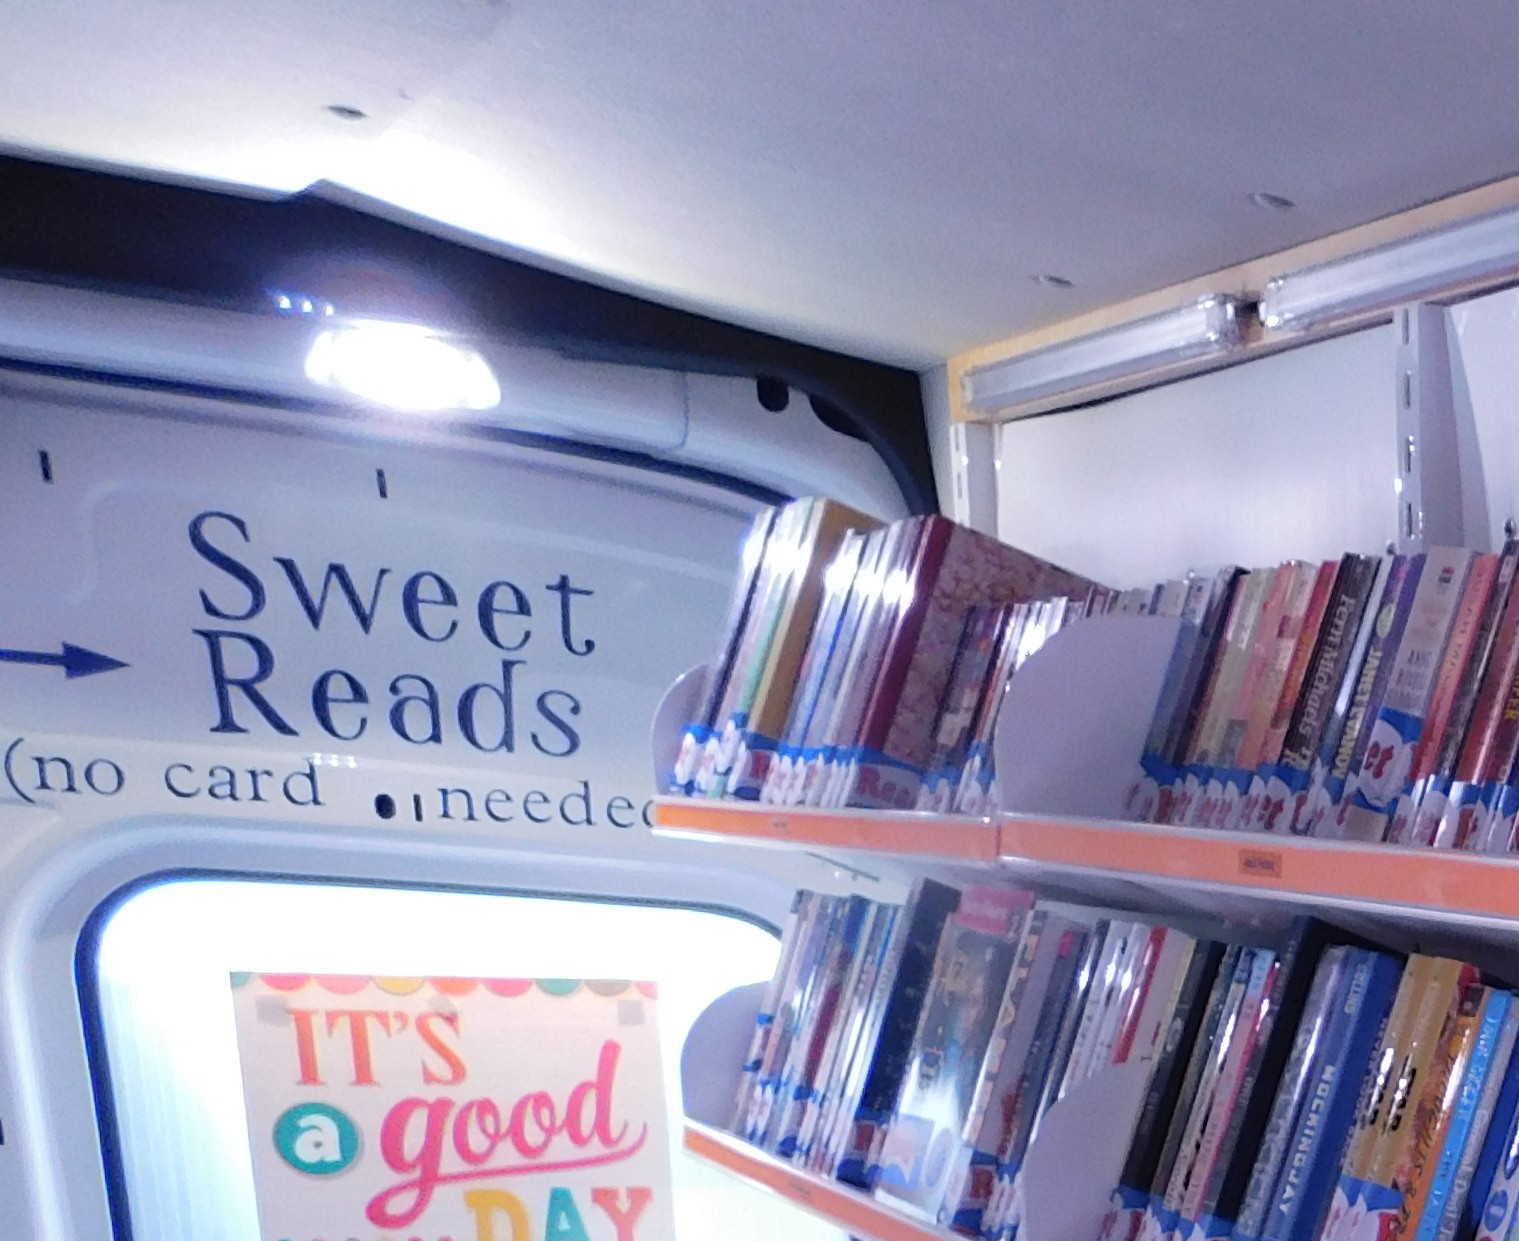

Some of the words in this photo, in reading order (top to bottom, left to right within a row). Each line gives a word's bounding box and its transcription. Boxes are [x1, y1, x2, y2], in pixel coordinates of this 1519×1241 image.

[188, 510, 597, 658] Sweet
[193, 628, 584, 757] Reads
[3, 737, 126, 803] (no
[164, 758, 327, 808] card
[286, 1006, 469, 1088] IT'S
[292, 1109, 341, 1163] a
[366, 1039, 648, 1230] good
[1280, 1064, 1336, 1216] MOCKINGJAY
